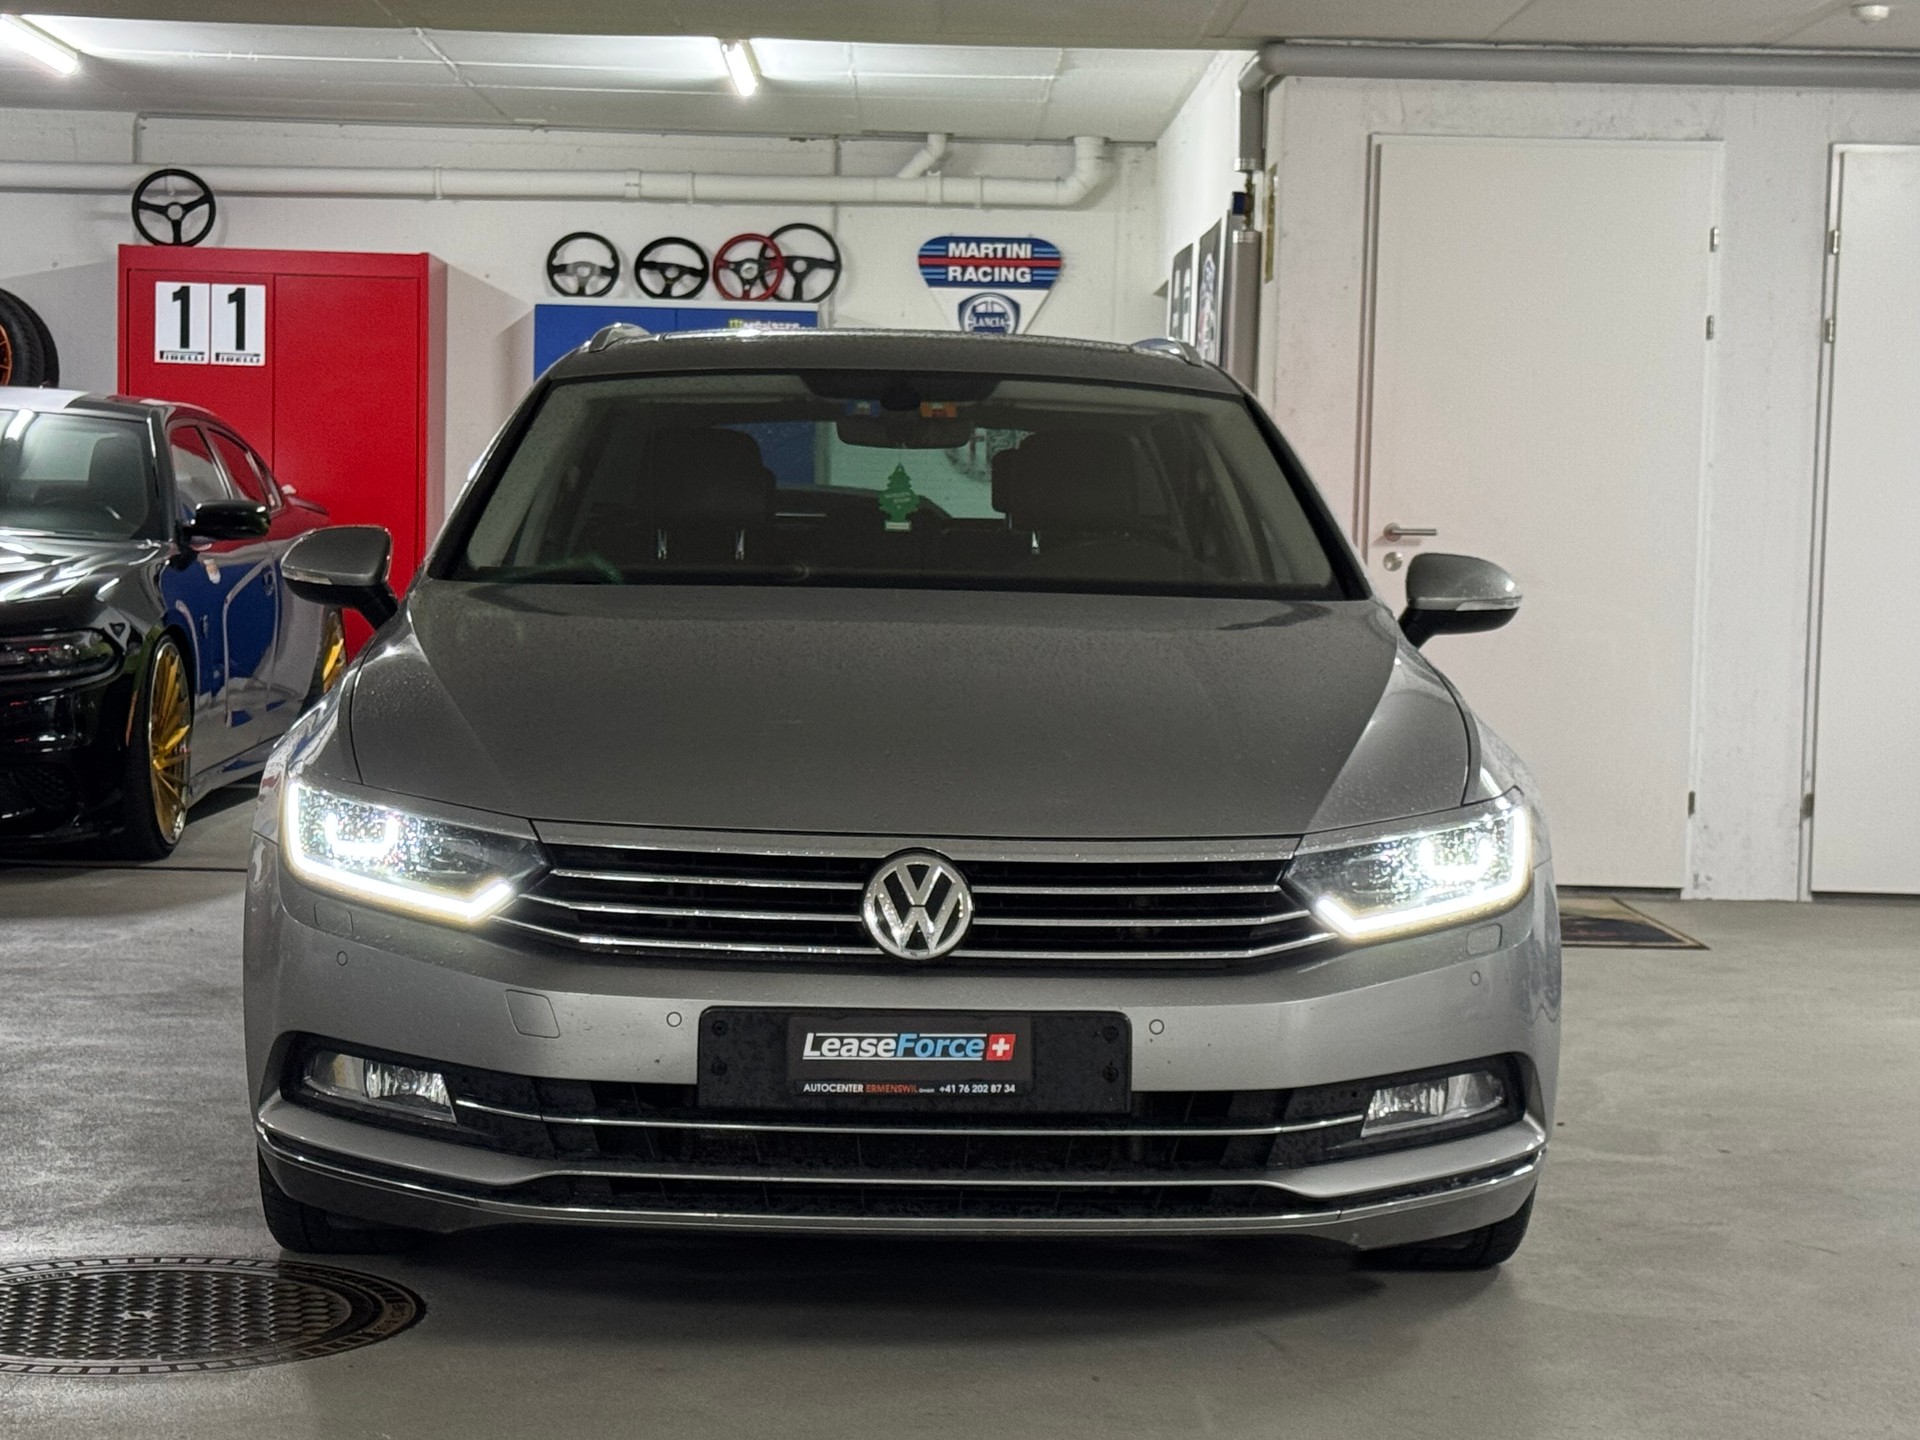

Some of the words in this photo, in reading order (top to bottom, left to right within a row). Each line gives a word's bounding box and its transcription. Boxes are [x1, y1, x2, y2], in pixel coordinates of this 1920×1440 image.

[948, 242, 1033, 259] MARTINI
[947, 266, 1033, 283] RACING
[803, 1032, 985, 1058] LeaseForce
[803, 1083, 864, 1093] AUTOCENTER
[865, 1084, 919, 1094] ERMENSWIL
[939, 1084, 957, 1093] +41
[958, 1084, 970, 1093] 76
[971, 1084, 989, 1093] 202
[990, 1084, 1003, 1093] 87
[1003, 1084, 1016, 1093] 34
